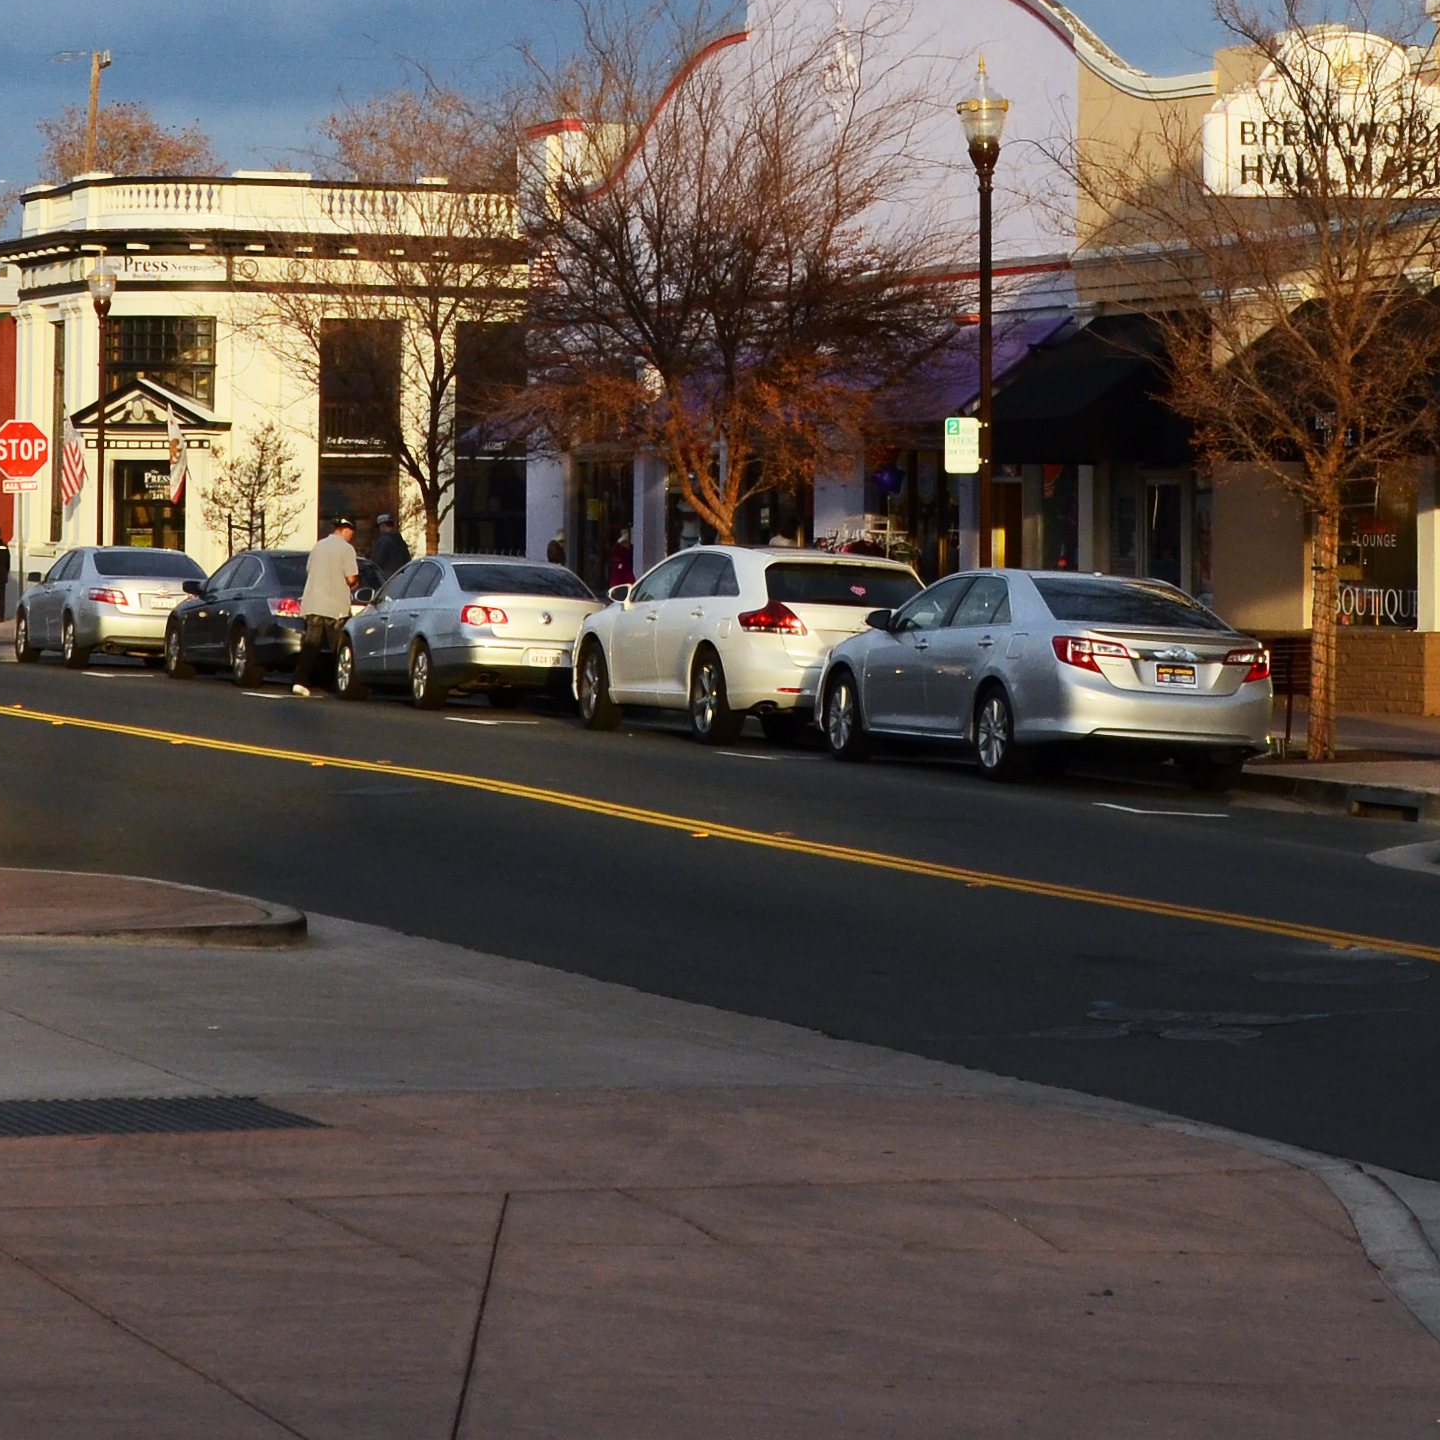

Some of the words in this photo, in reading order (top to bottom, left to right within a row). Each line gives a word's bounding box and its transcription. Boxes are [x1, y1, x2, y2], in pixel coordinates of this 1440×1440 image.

[123, 256, 169, 272] Press
[948, 421, 958, 433] 2
[1357, 533, 1397, 547] LOUNGE
